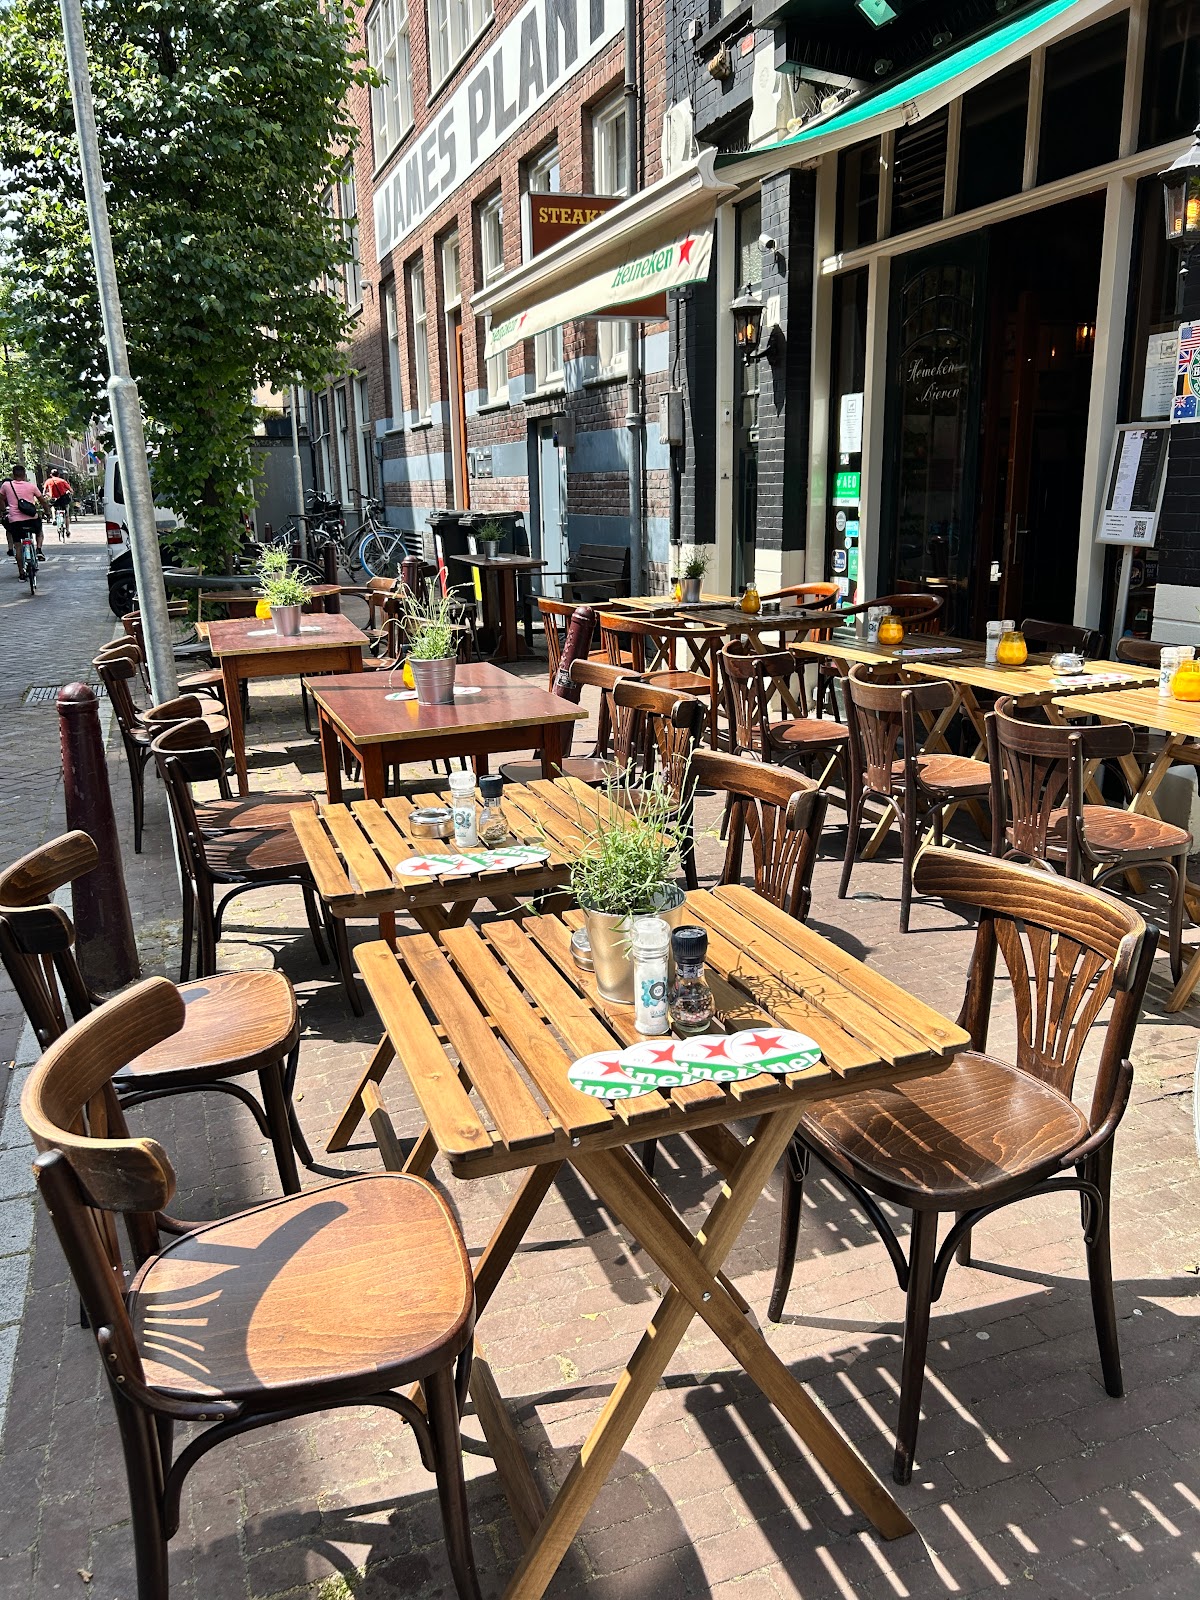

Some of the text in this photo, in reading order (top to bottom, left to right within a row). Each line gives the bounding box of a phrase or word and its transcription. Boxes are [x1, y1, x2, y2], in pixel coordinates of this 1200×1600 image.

[379, 107, 457, 244] JAMES
[538, 206, 607, 225] STEAK
[611, 248, 674, 288] Heineken
[906, 356, 955, 384] Heineken
[916, 381, 962, 403] Bieren
